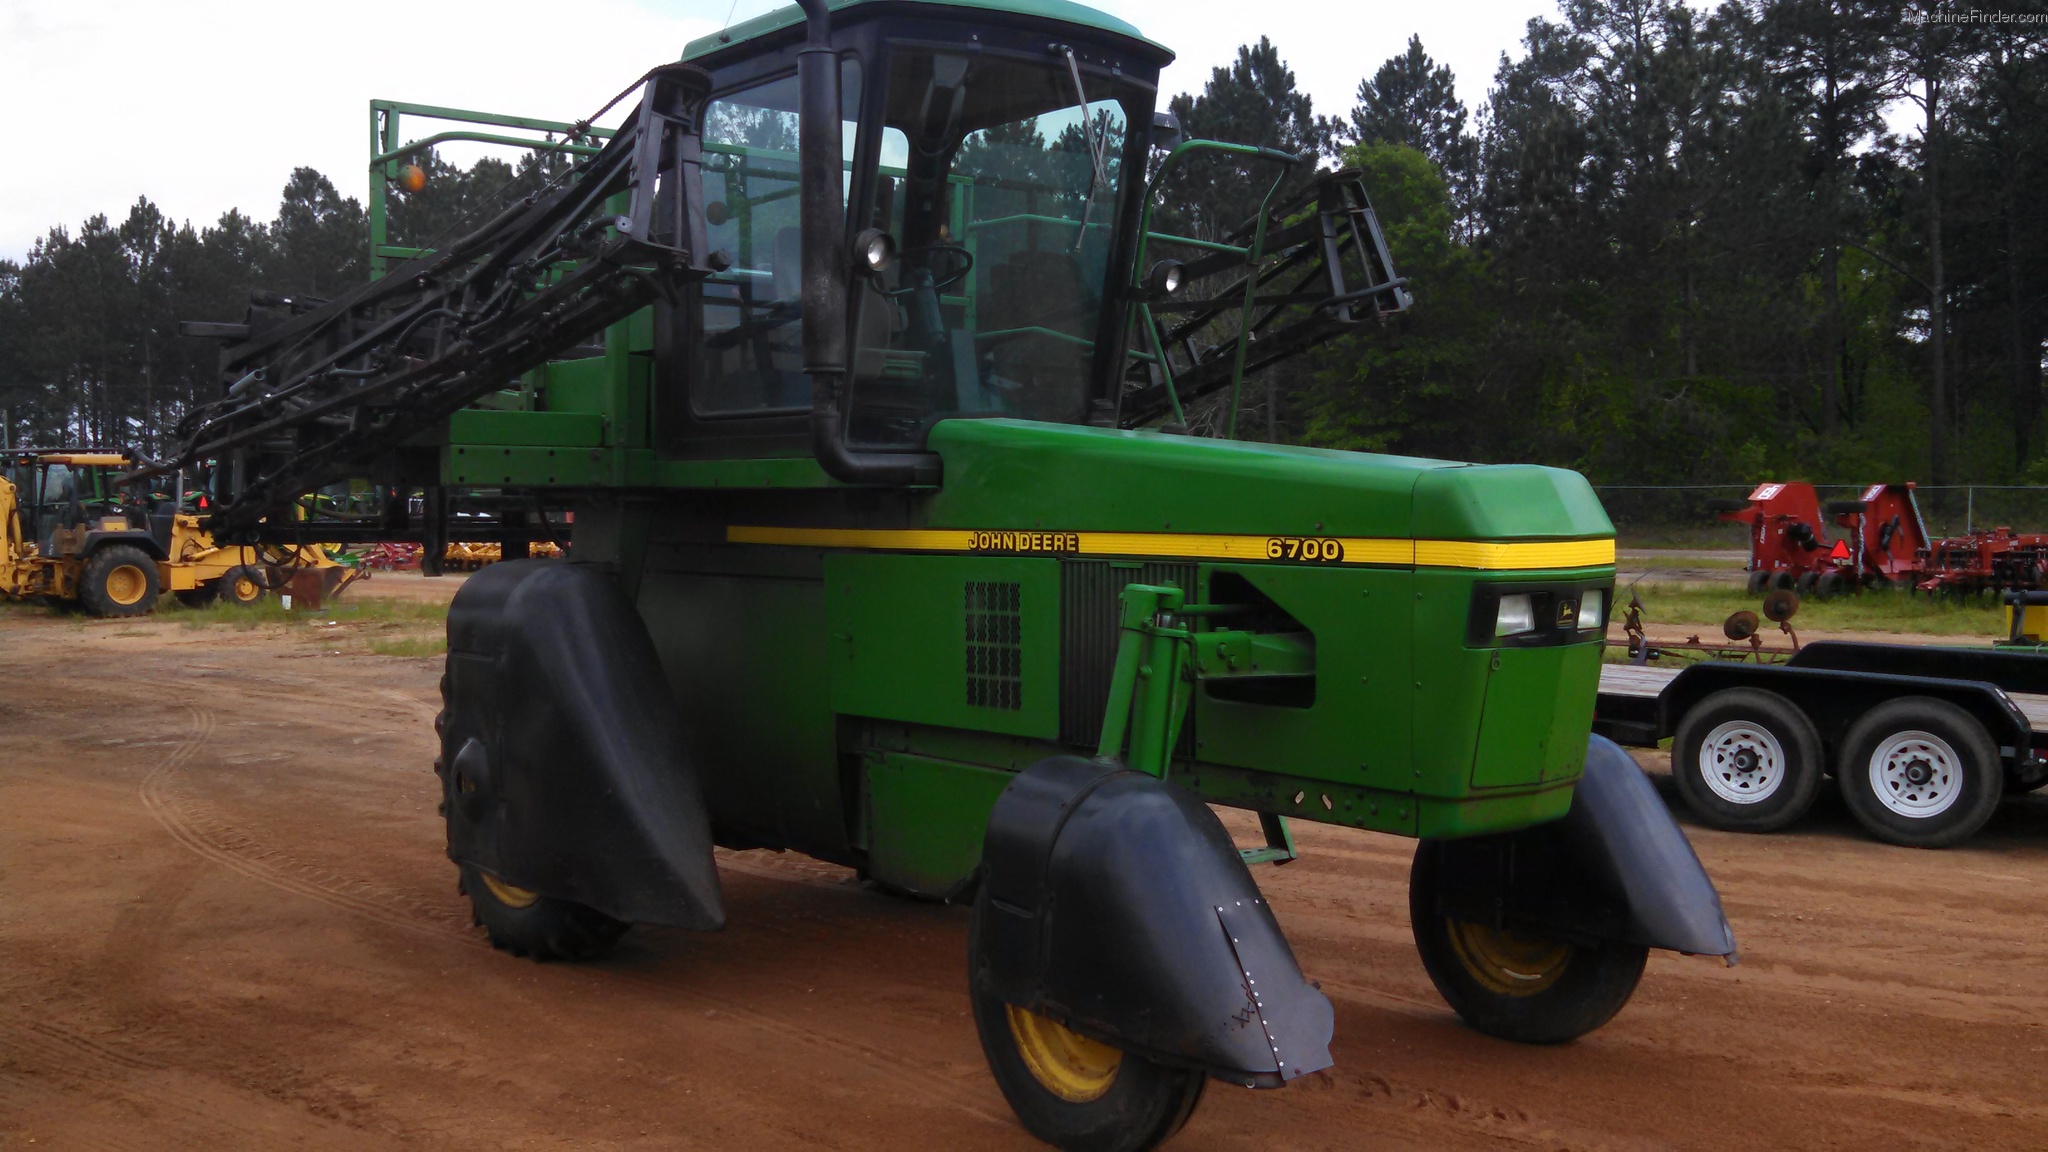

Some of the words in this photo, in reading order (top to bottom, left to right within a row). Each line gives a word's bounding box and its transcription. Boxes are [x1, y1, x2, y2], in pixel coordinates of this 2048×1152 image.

[968, 531, 1016, 551] JOHN
[1018, 533, 1079, 552] DEERE
[1267, 538, 1344, 560] 6700
